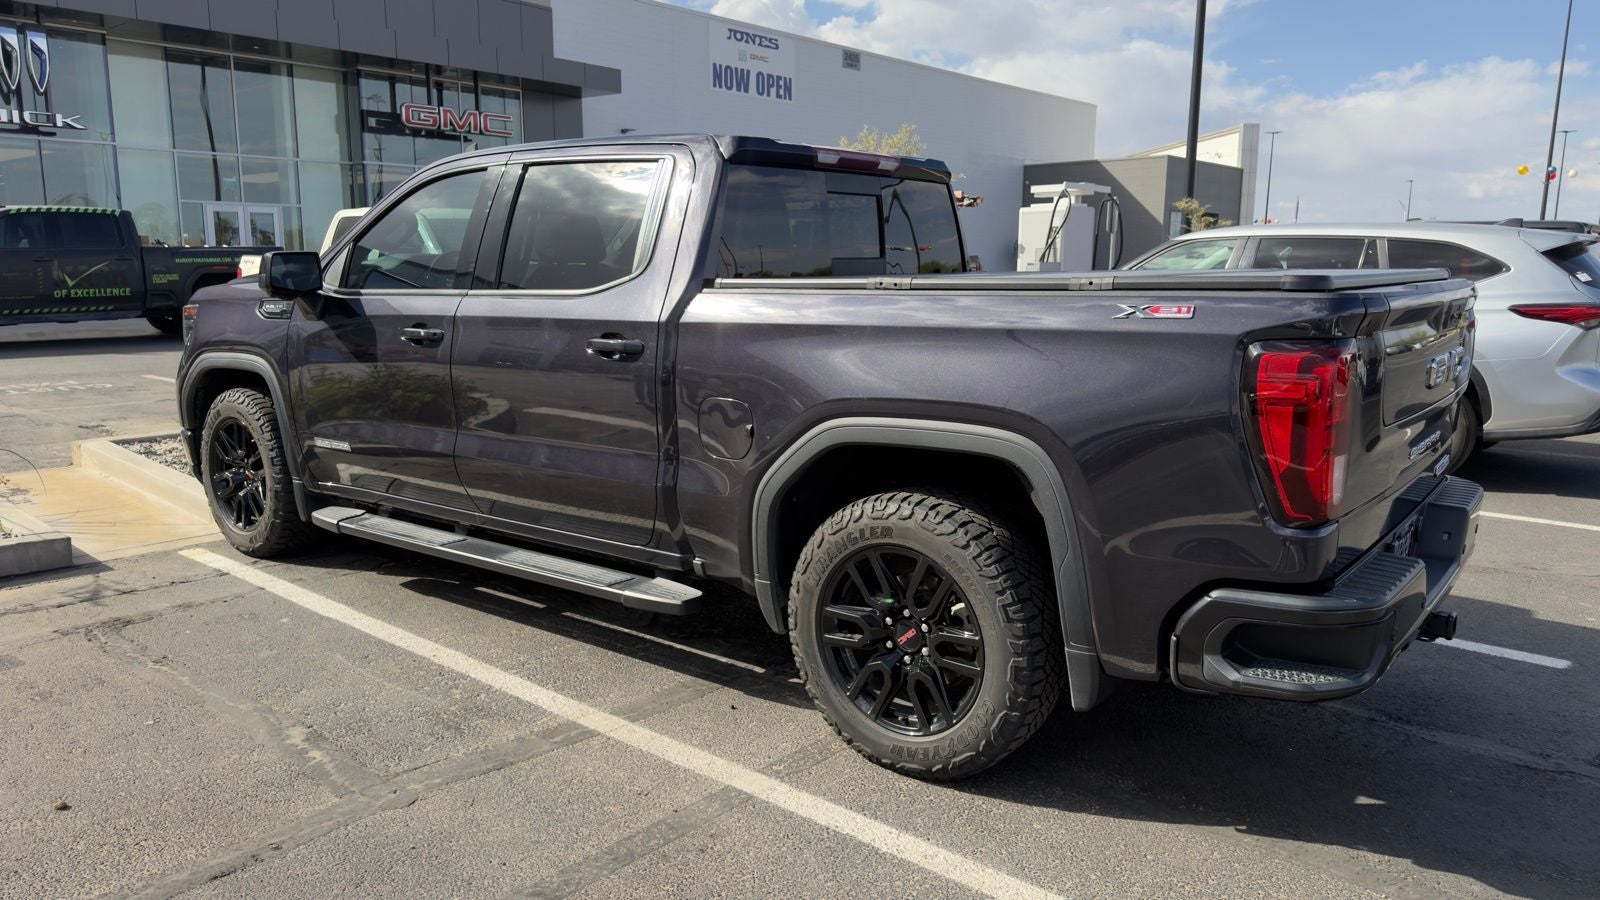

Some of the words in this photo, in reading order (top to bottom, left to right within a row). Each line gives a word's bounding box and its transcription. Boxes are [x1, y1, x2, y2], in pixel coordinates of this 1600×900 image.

[727, 28, 779, 50] JONES
[750, 53, 769, 63] GMC
[712, 62, 750, 94] NOW
[756, 71, 793, 101] OPEN
[401, 102, 513, 137] GMC
[54, 289, 68, 298] OF
[70, 287, 131, 298] EXCELLENCE
